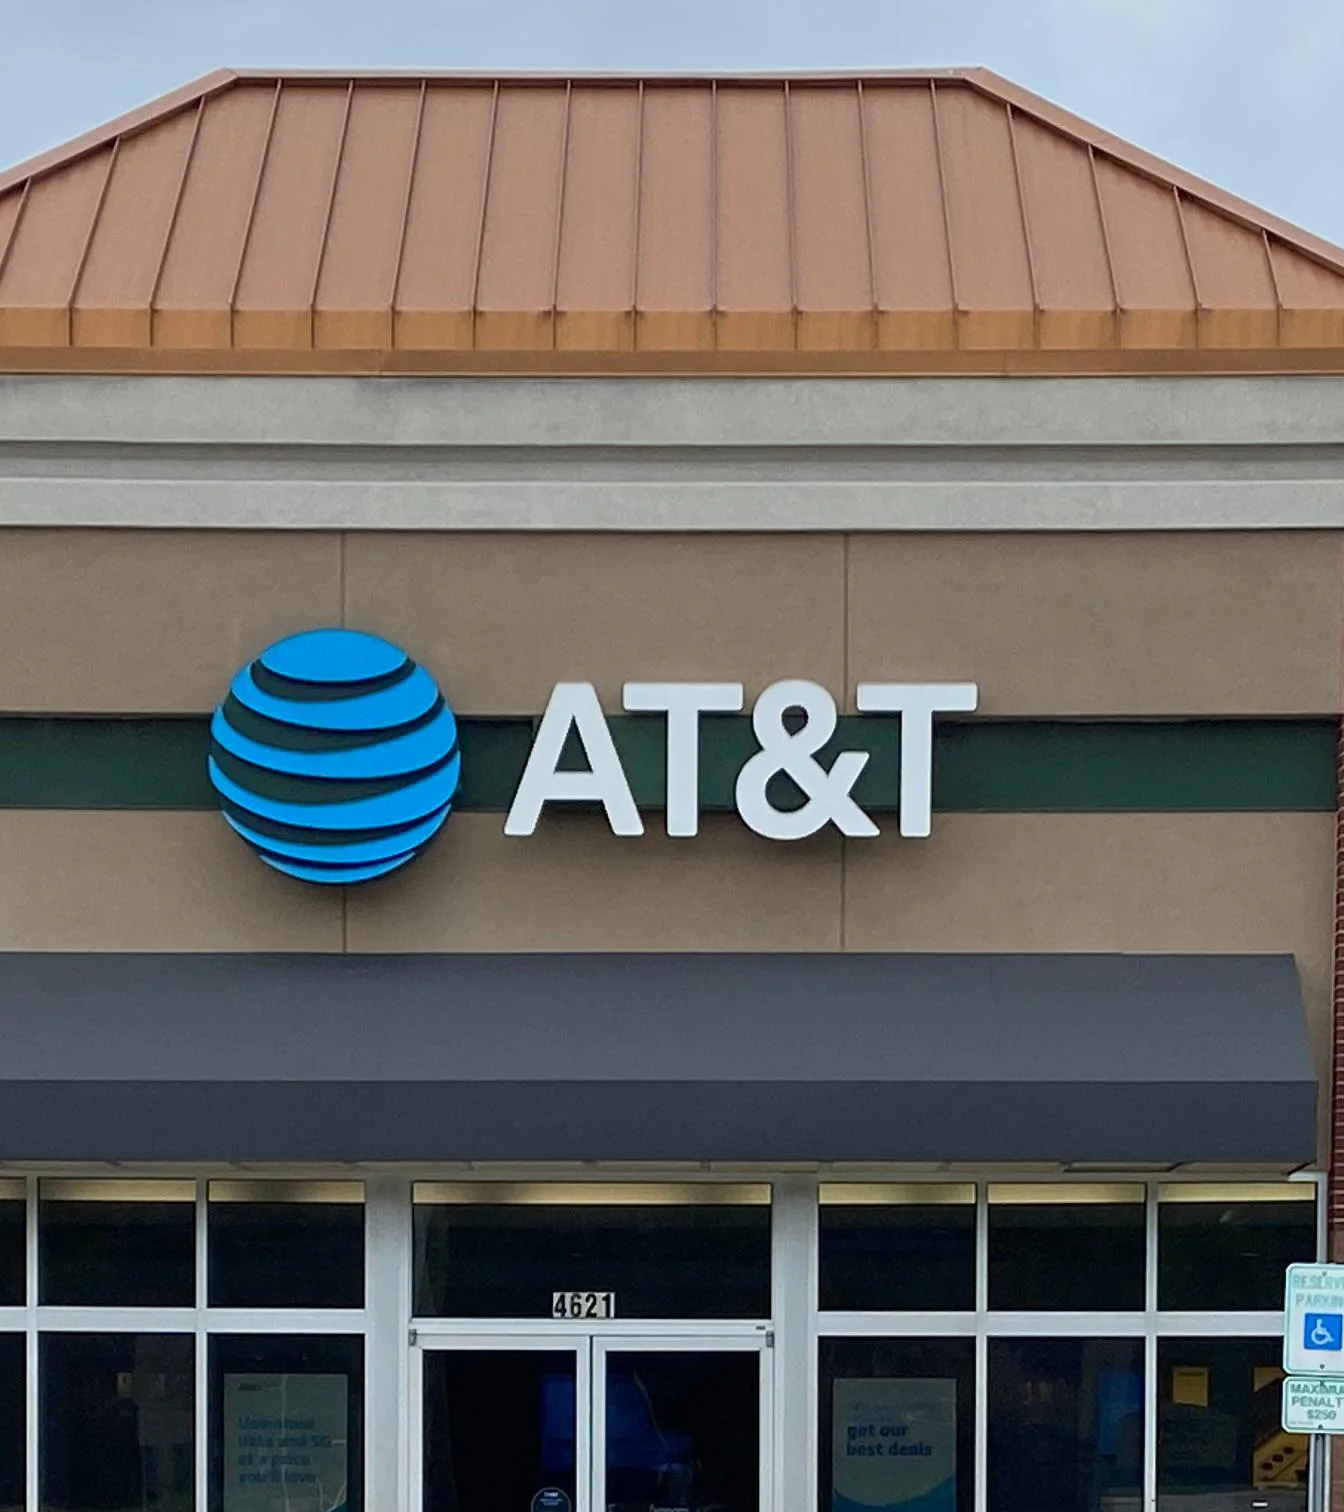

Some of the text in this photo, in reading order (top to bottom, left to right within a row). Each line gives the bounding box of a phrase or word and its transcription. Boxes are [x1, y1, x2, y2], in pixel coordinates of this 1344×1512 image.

[503, 679, 978, 841] AT&T
[554, 1292, 612, 1318] 4621
[1307, 1409, 1337, 1420] $250
[847, 1424, 909, 1440] get our
[311, 1434, 332, 1447] 5G
[846, 1441, 933, 1457] best deals
